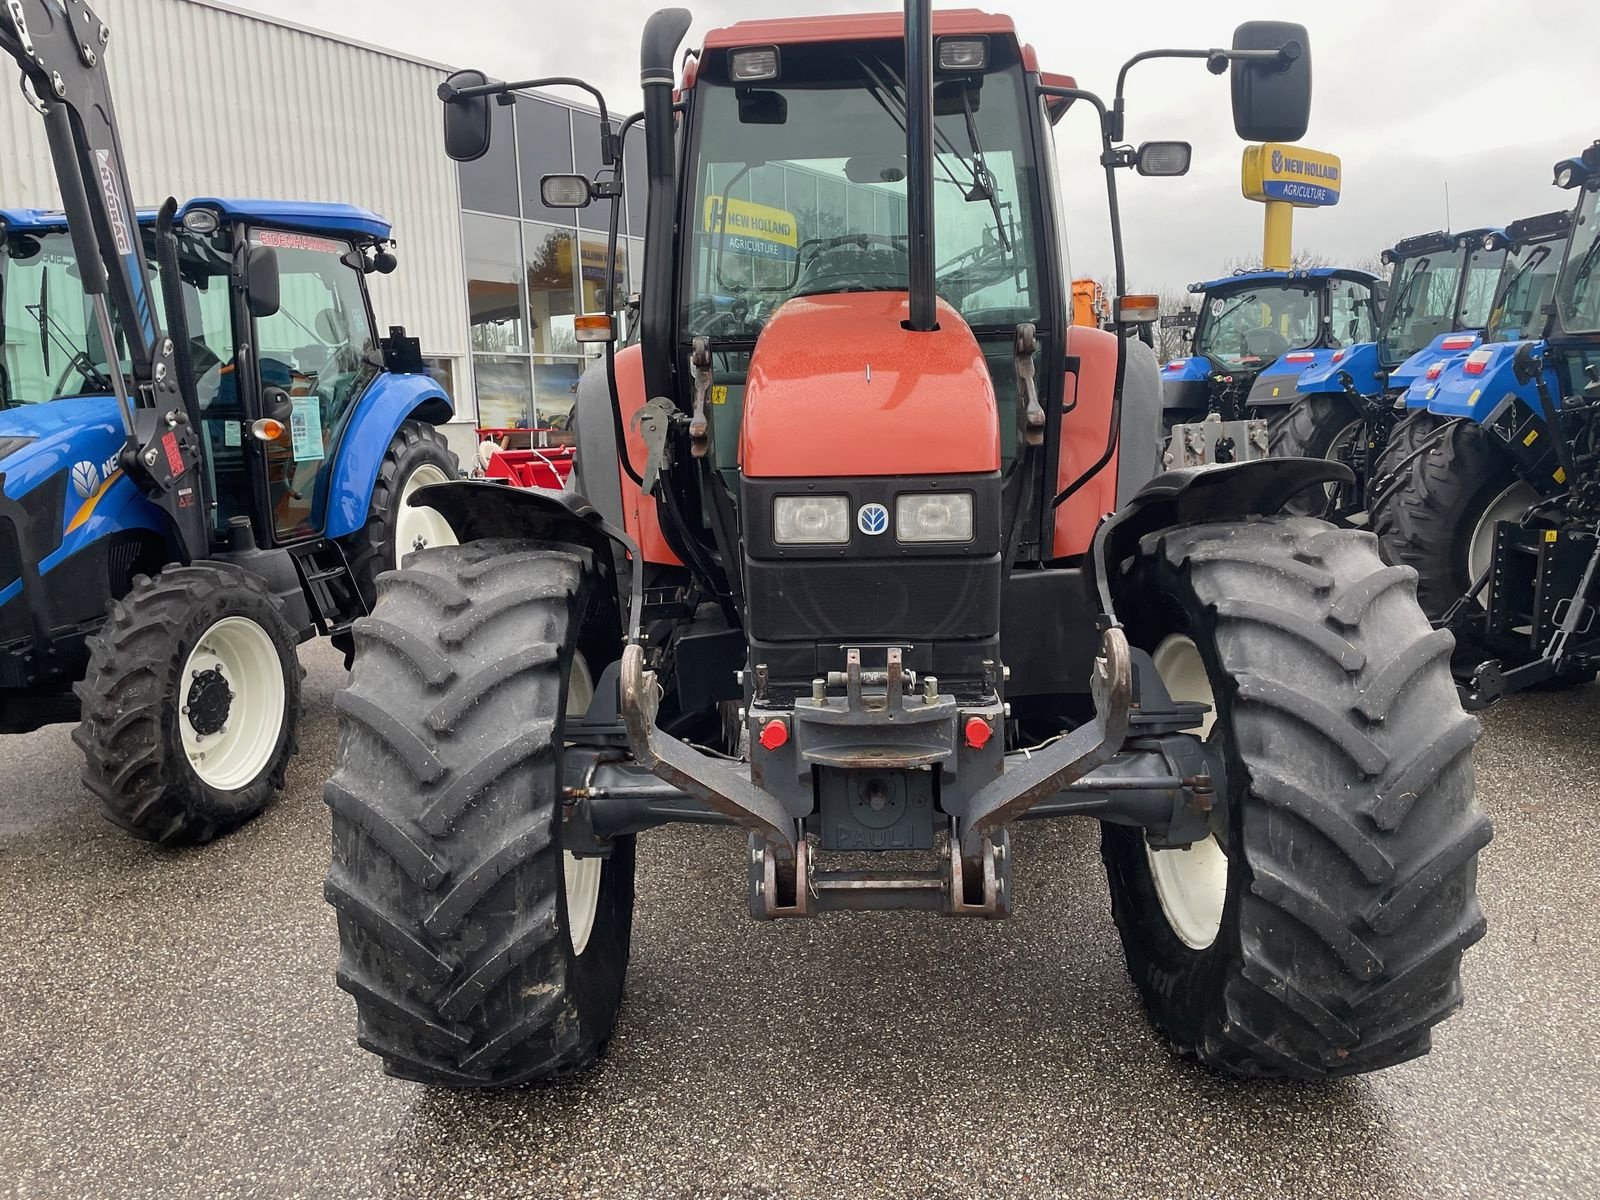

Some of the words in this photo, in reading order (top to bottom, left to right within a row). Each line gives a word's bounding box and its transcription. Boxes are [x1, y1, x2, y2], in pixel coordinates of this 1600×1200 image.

[1284, 157, 1303, 174] NEW
[1304, 161, 1338, 181] HOLLAND
[1282, 184, 1326, 201] AGRICULTURE
[728, 212, 750, 229] NEW
[751, 216, 791, 236] HOLLAND
[729, 237, 779, 255] AGRICULTURE
[835, 823, 914, 848] PAULI
